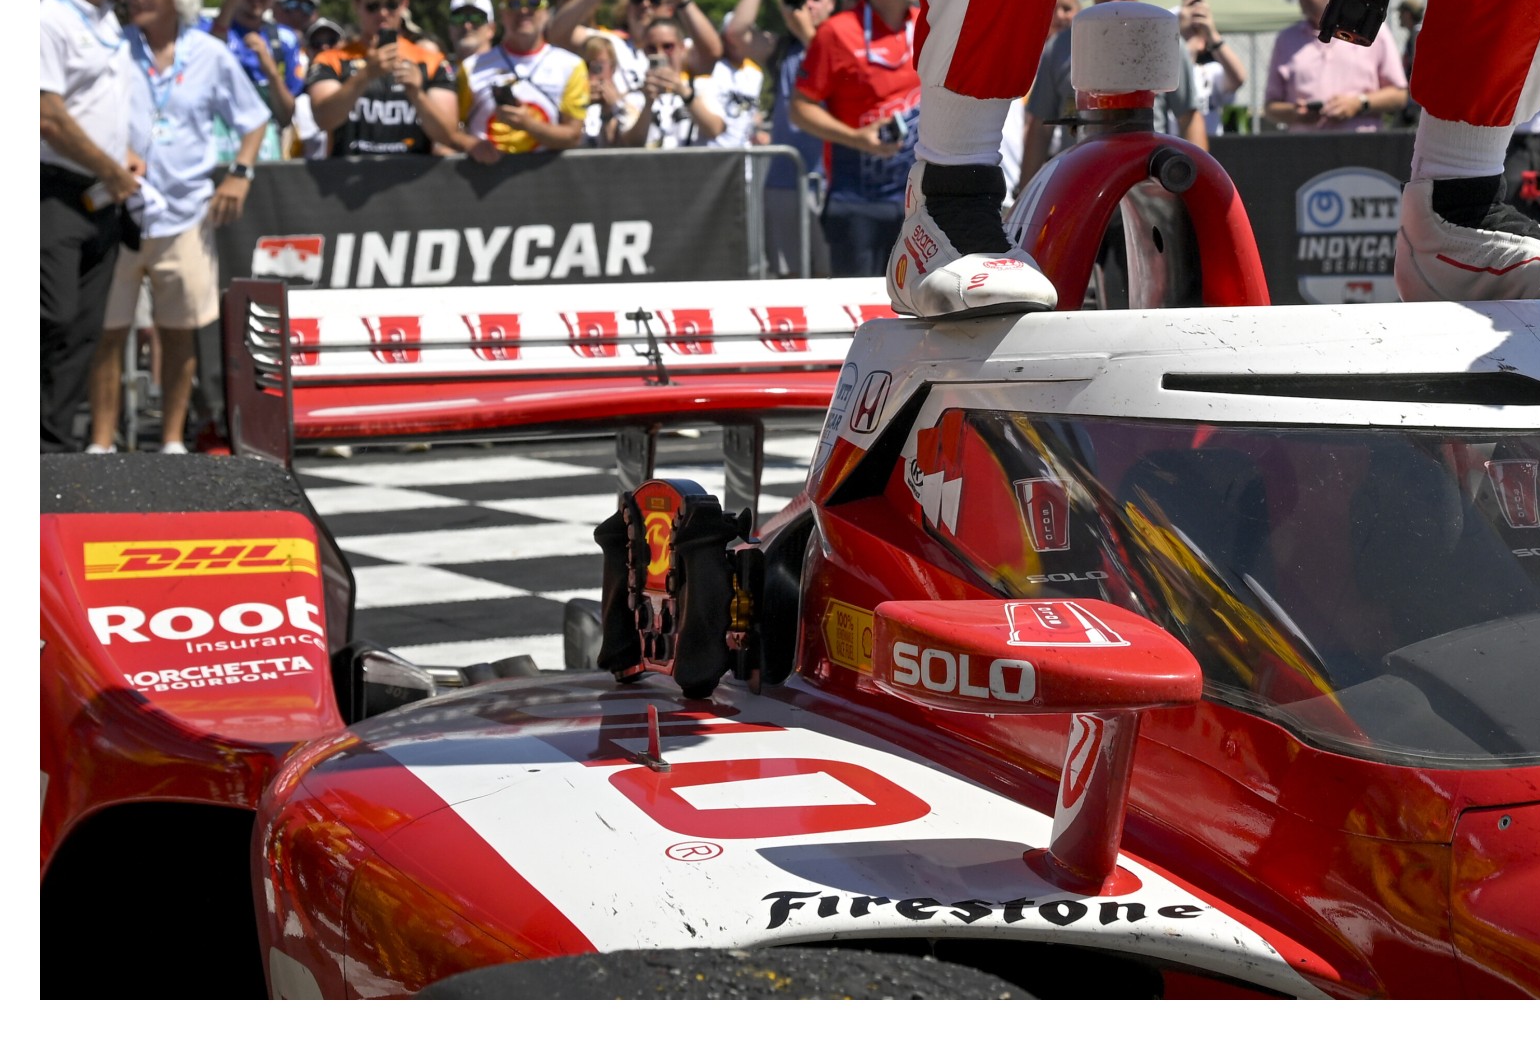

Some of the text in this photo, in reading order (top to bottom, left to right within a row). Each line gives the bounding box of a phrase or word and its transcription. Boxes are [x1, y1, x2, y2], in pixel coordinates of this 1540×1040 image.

[1350, 197, 1399, 219] NTT
[329, 220, 652, 289] INDYCAR
[1297, 235, 1398, 260] INDYCA
[1321, 260, 1388, 274] SERIES
[1514, 488, 1526, 518] SOLO
[1042, 509, 1054, 541] SOLO
[116, 544, 289, 572] DHL
[1026, 570, 1110, 584] SOLO
[88, 596, 324, 644] Root
[187, 633, 326, 654] Insurance
[154, 671, 278, 692] BOURBON
[893, 641, 1036, 701] SOLO
[760, 890, 1207, 930] Firestone
